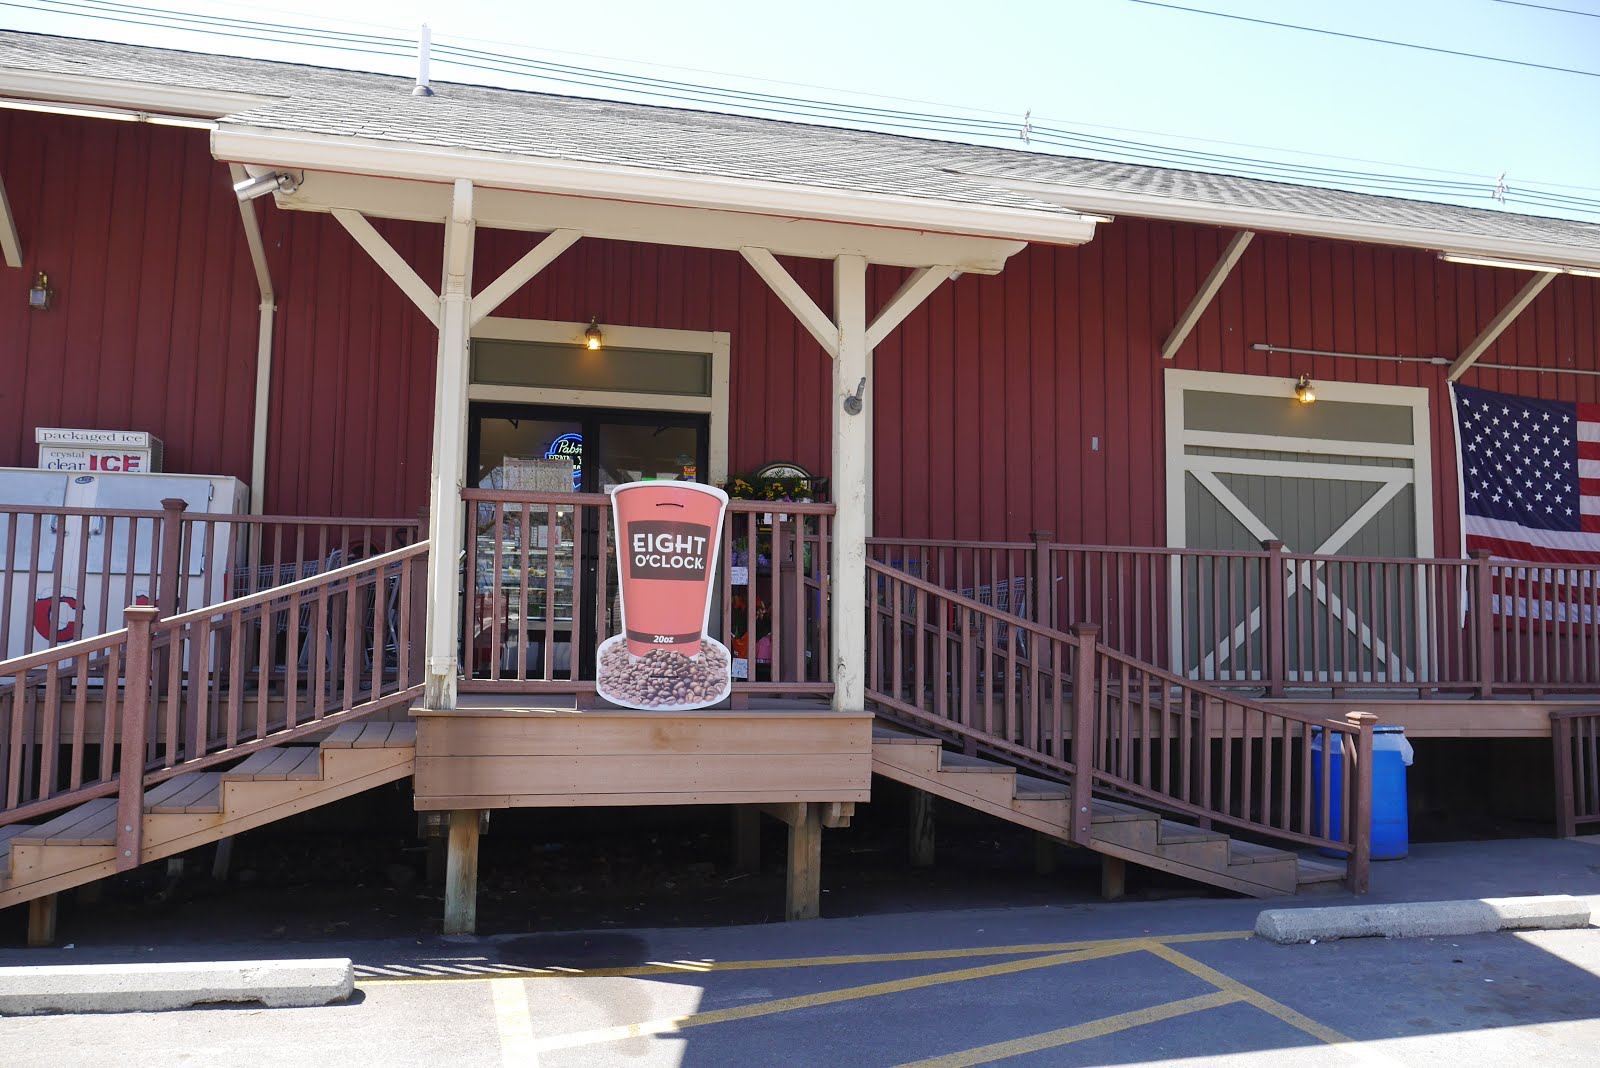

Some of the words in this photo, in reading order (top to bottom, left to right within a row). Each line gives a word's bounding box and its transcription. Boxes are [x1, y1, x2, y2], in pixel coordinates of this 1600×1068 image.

[43, 431, 116, 443] packaged
[121, 434, 143, 442] ice
[50, 450, 85, 459] crystal
[47, 458, 86, 470] clear
[89, 453, 141, 473] ICE
[633, 533, 706, 555] EIGHT
[635, 554, 704, 570] O'CLOCK
[653, 635, 674, 644] 20oz
